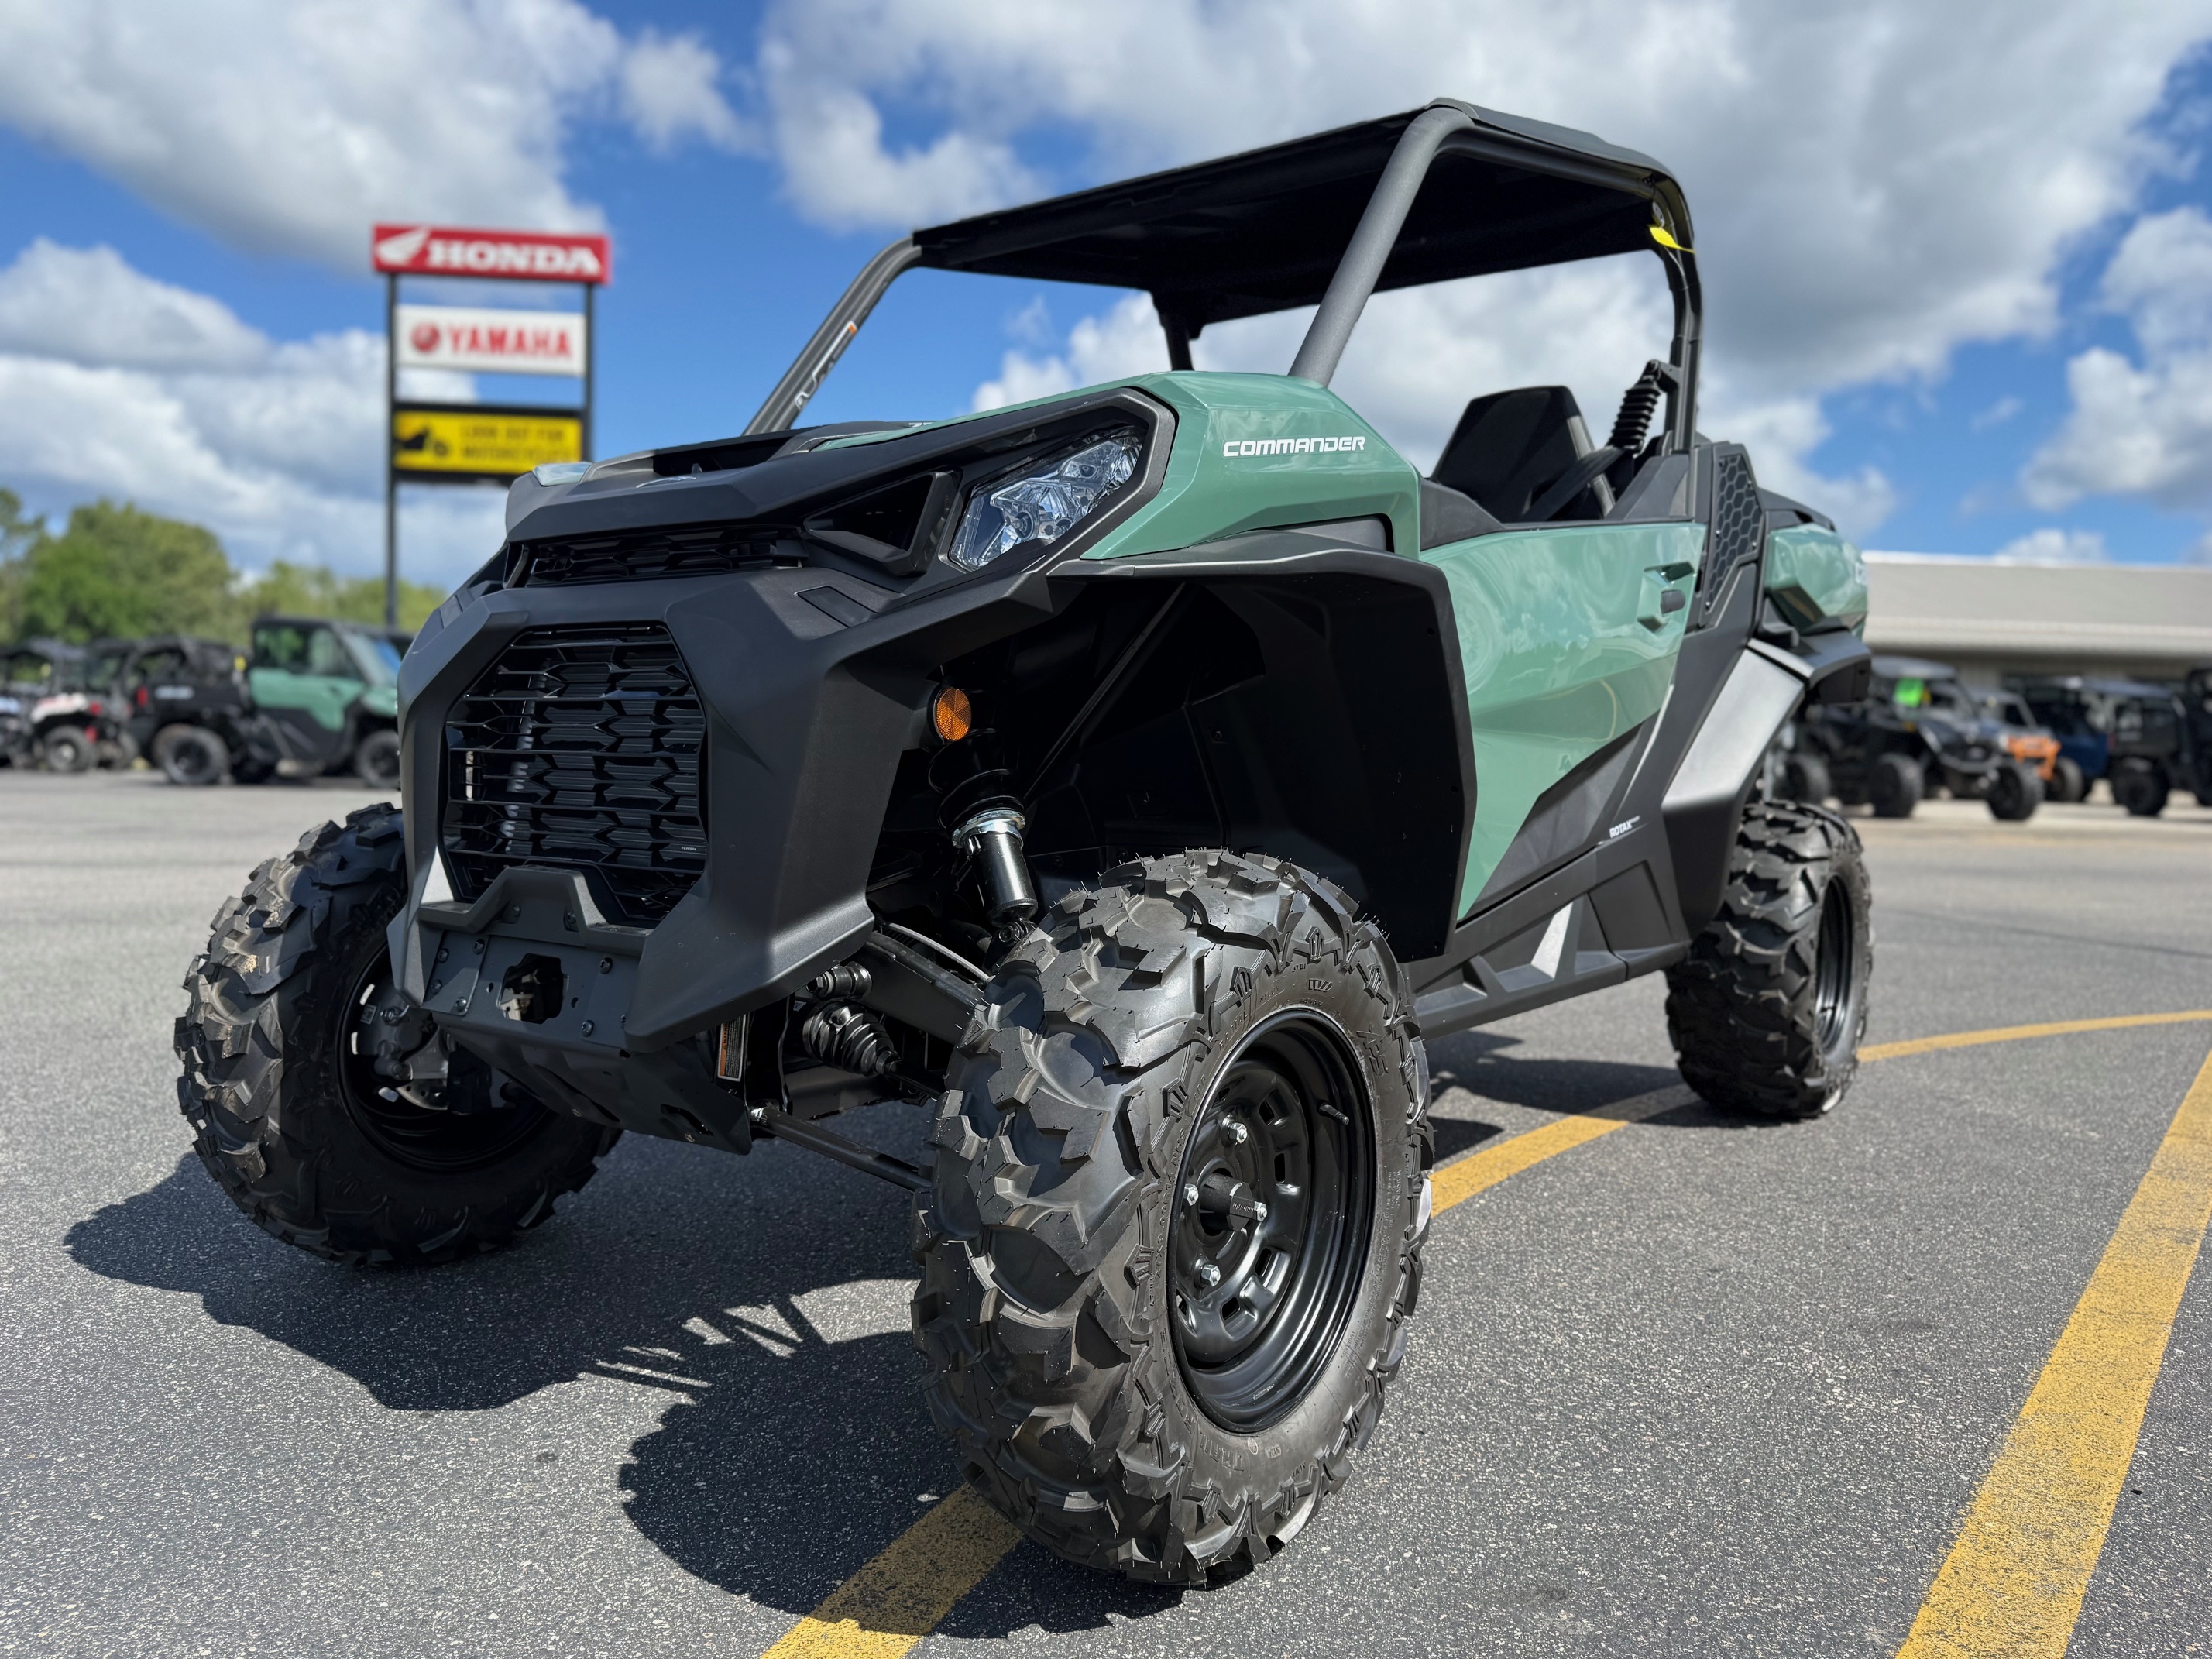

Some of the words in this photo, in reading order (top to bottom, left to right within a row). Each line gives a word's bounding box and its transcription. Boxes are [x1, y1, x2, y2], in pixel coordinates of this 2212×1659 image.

[428, 240, 602, 275] HONDA
[449, 325, 571, 359] YAMAHA
[1222, 435, 1366, 458] COMMANDER
[1609, 819, 1633, 839] ROTAX
[1170, 1128, 1187, 1167] NHS
